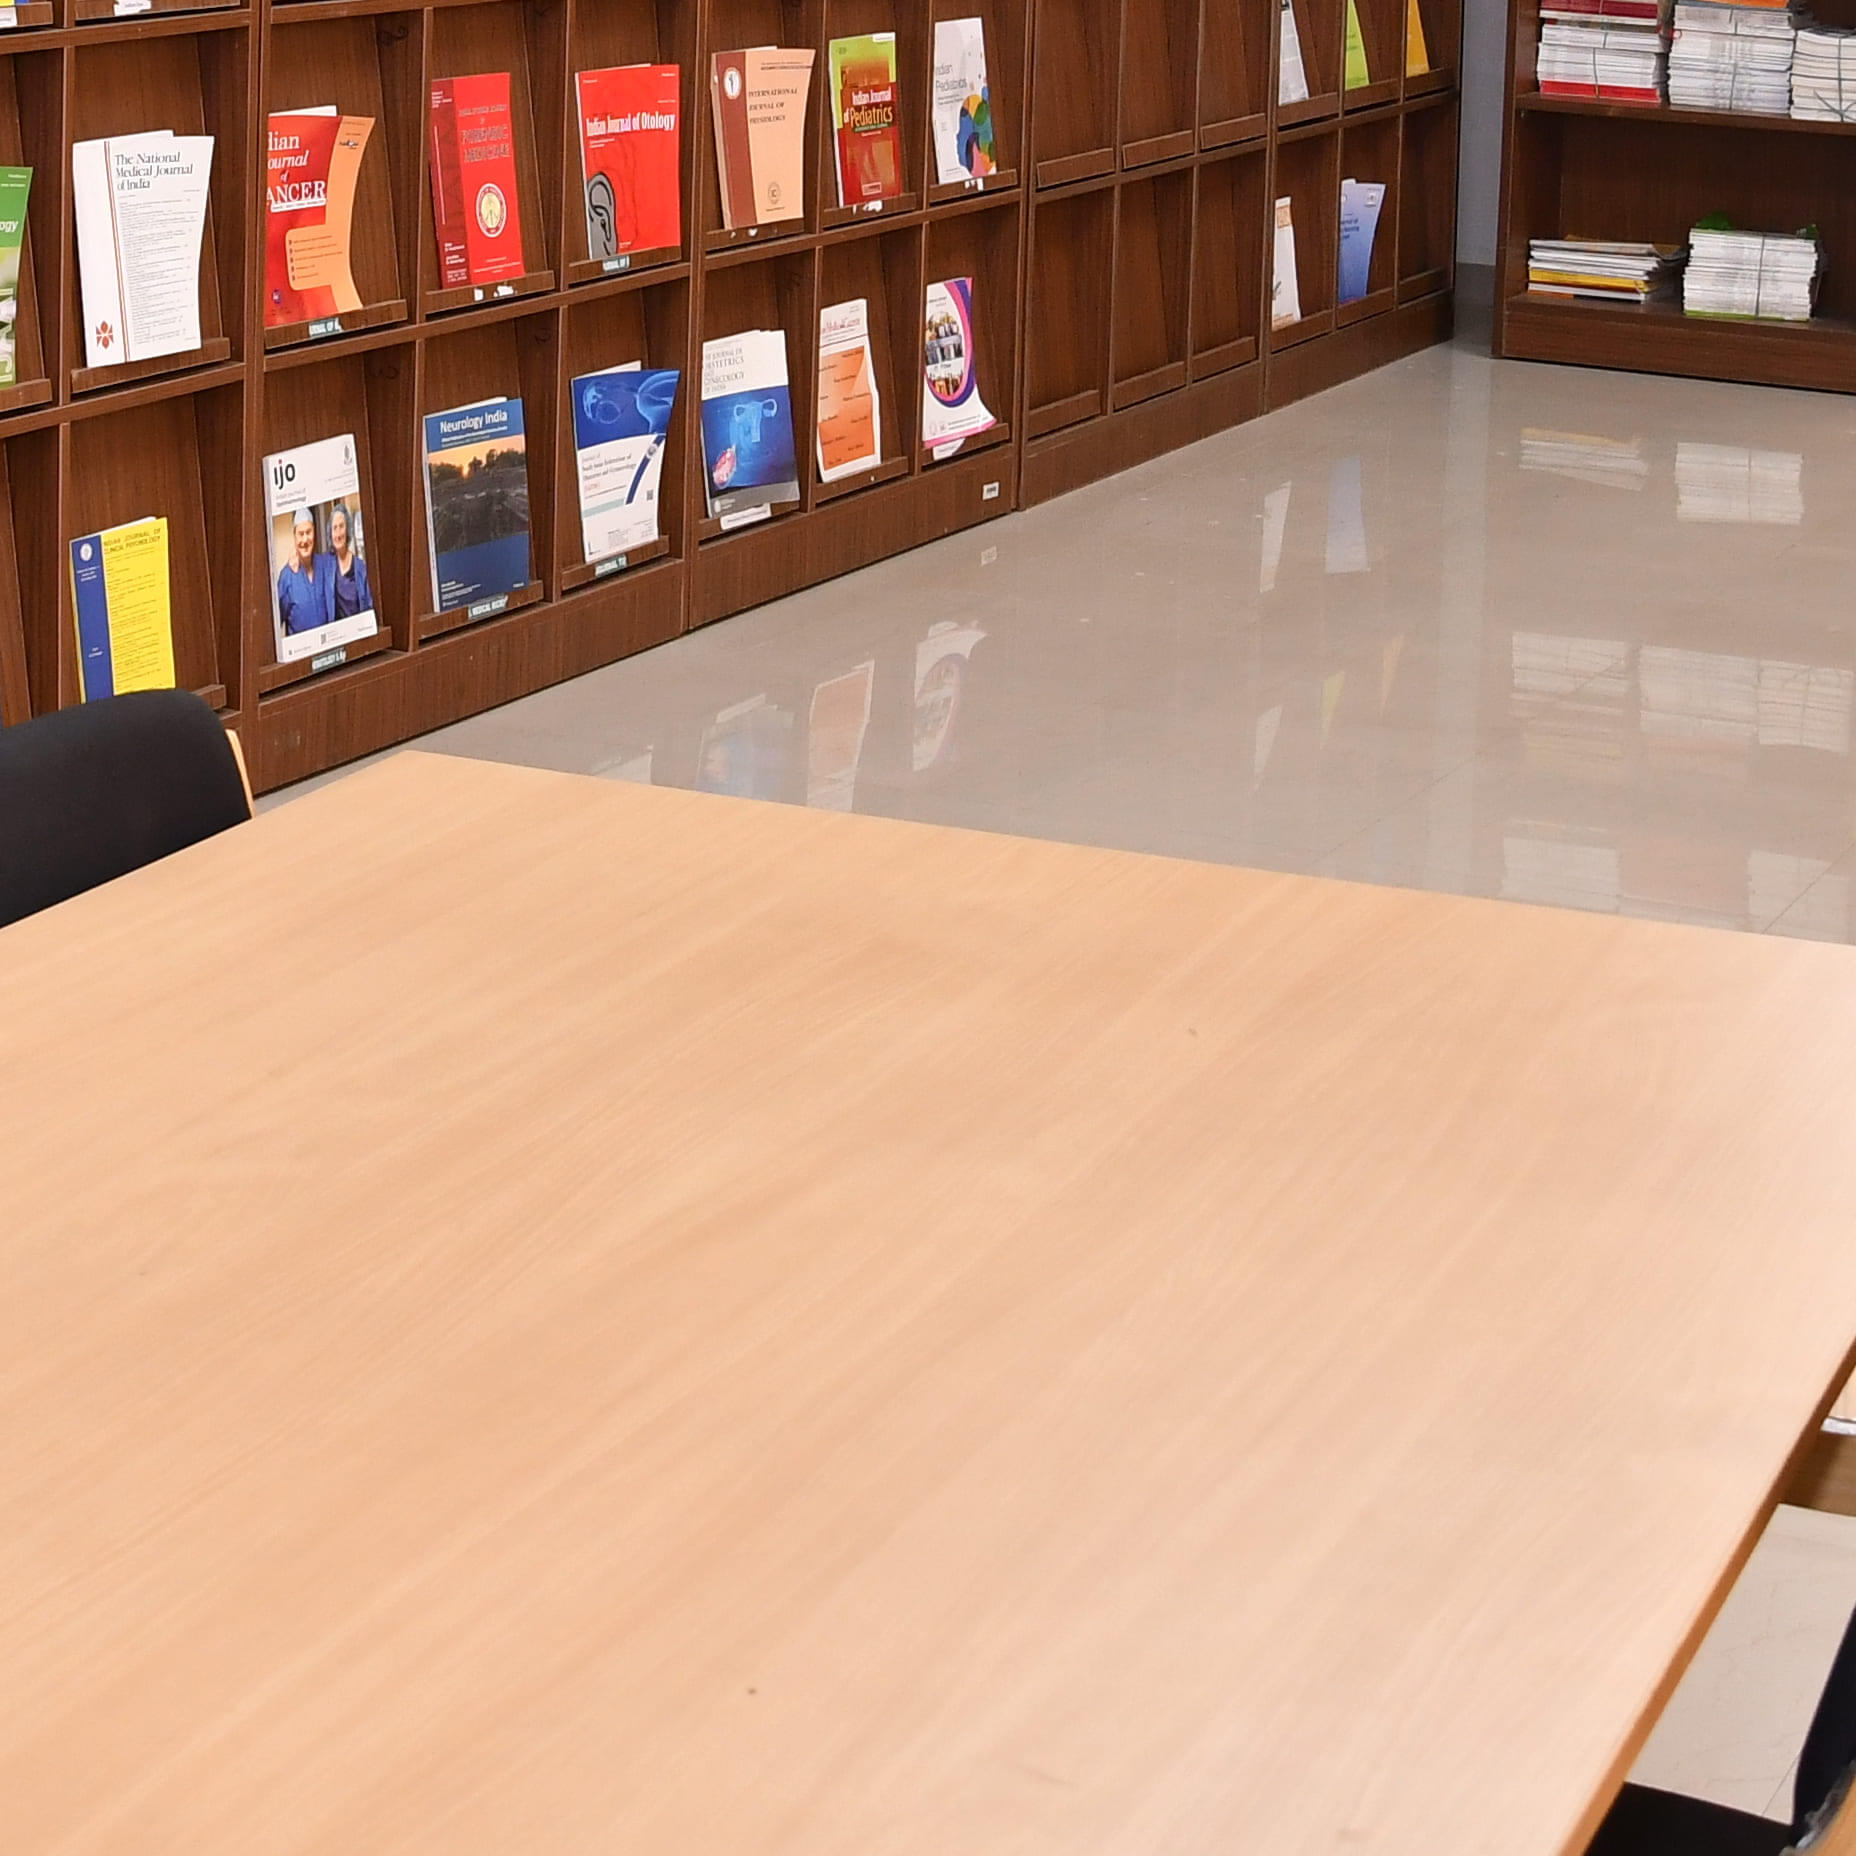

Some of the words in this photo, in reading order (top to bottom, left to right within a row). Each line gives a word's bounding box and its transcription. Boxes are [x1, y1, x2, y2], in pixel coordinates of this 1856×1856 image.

[852, 91, 870, 106] Indian
[870, 88, 892, 104] Journal
[586, 119, 606, 137] Indian
[608, 116, 631, 136] Journal
[632, 114, 640, 132] of
[641, 112, 676, 132] Otology
[844, 107, 850, 123] of
[850, 104, 893, 128] Pediatrics
[116, 153, 134, 166] The
[136, 151, 180, 164] National
[116, 164, 152, 179] Medical
[153, 163, 193, 178] Journal
[280, 170, 289, 182] of
[117, 179, 126, 191] of
[126, 178, 152, 190] India
[440, 417, 483, 436] Neurology
[485, 412, 508, 428] India
[274, 459, 296, 490] ijo
